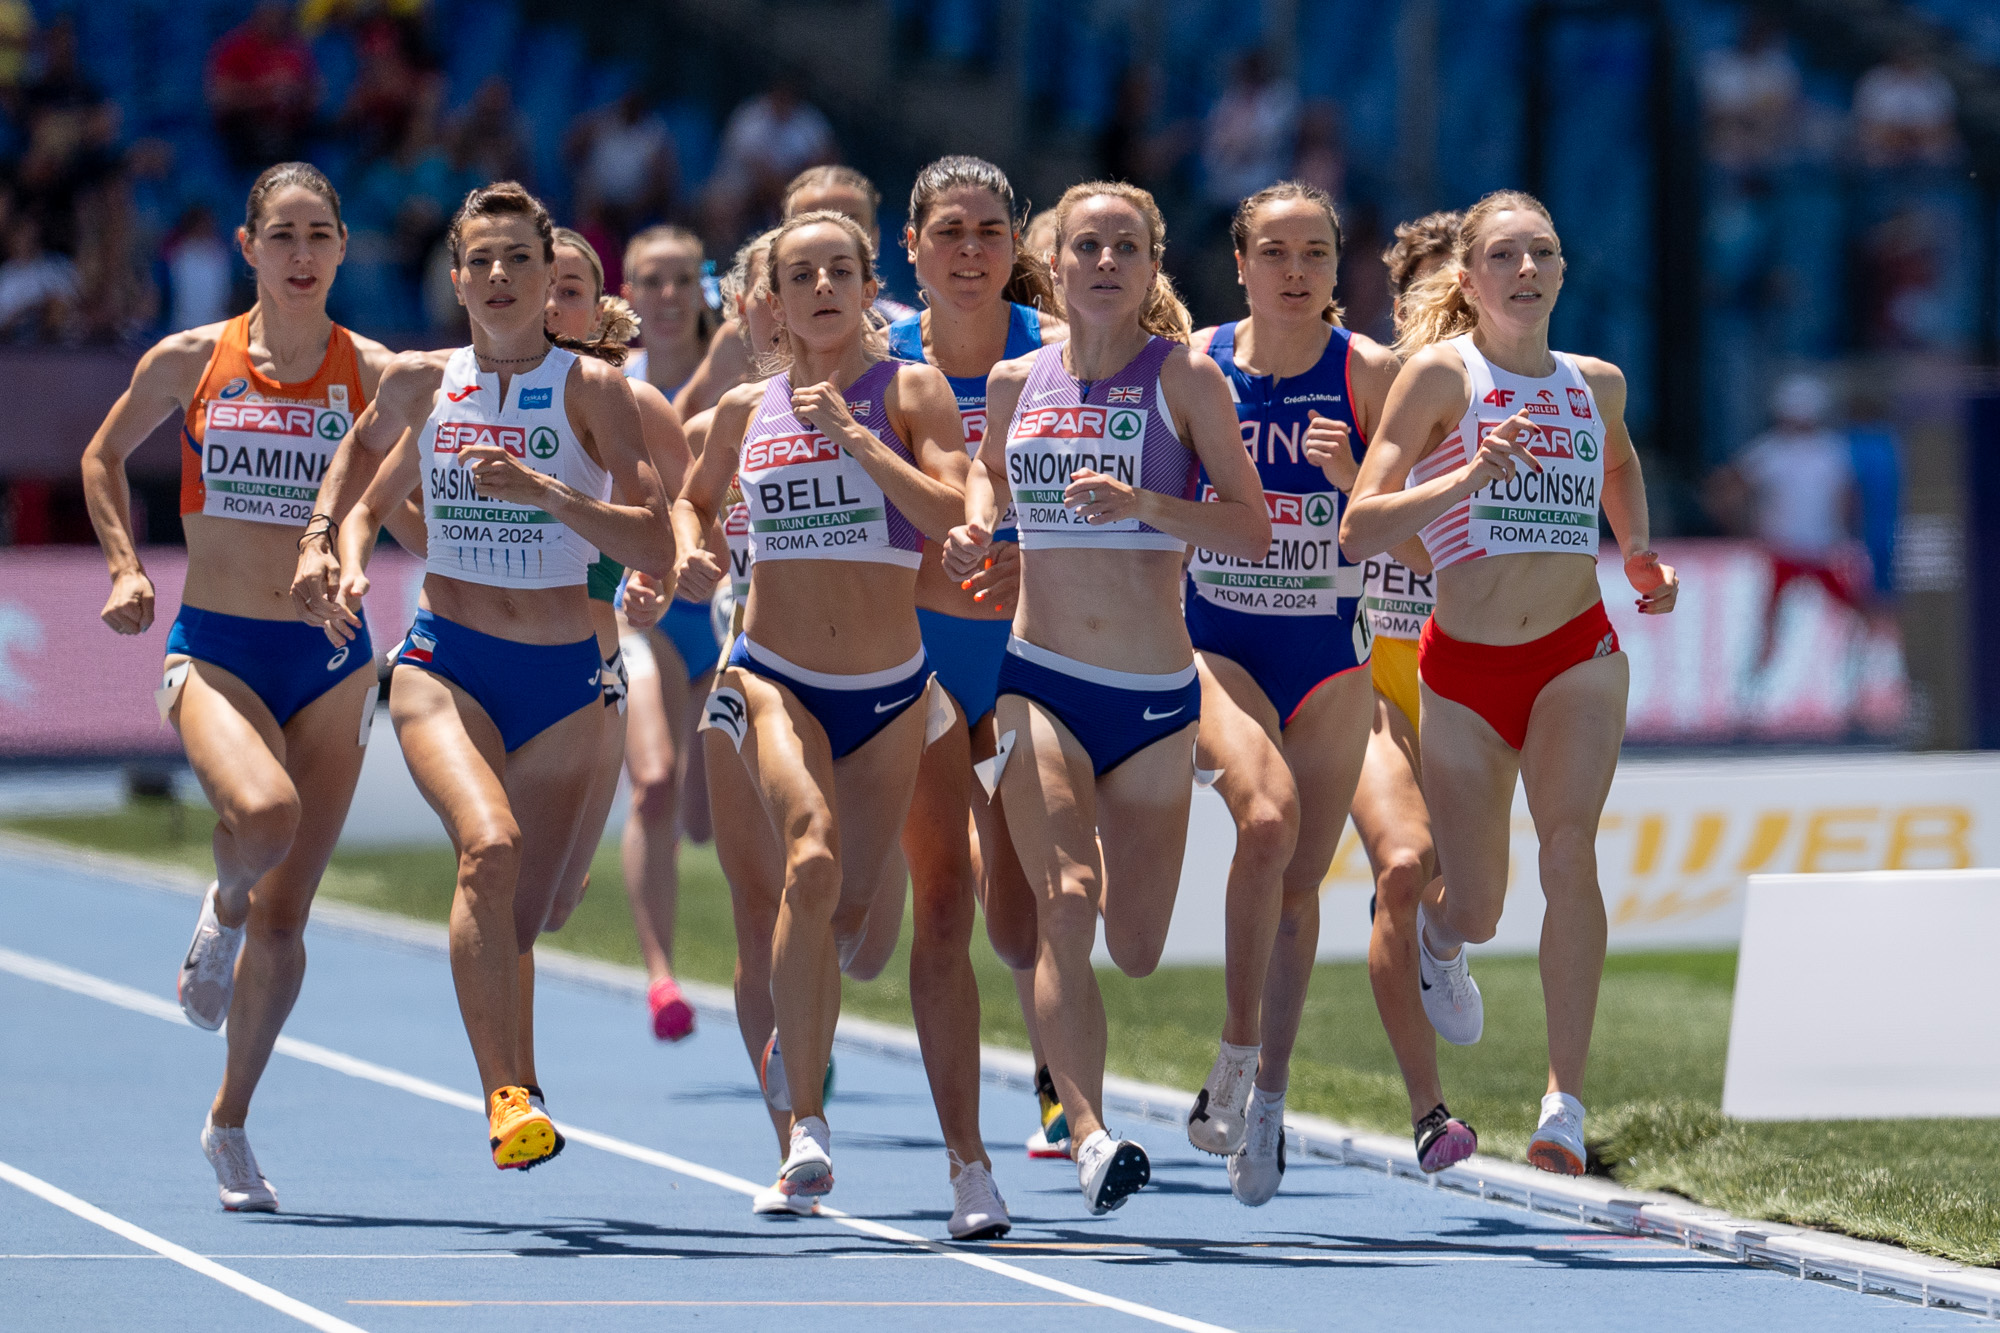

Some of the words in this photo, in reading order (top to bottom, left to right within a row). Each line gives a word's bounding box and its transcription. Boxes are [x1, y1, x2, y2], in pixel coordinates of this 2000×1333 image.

[1315, 394, 1341, 402] Mutuel
[1484, 389, 1516, 407] 4F
[212, 406, 312, 433] SPAR
[1527, 406, 1558, 414] ORLEN
[1018, 410, 1103, 436] SPAR
[437, 426, 523, 454] SPAR
[747, 436, 836, 468] SPAR
[236, 483, 266, 494] RUN
[759, 475, 861, 514] BELL
[1037, 491, 1059, 501] RUN
[1474, 465, 1595, 509] ŁOCIŃSKA
[224, 496, 275, 516] ROMA
[280, 503, 313, 520] 202
[454, 509, 482, 520] RUN
[1029, 507, 1069, 524] ROMA
[1508, 509, 1536, 521] RUN
[780, 518, 806, 529] RUN
[442, 524, 493, 542] ROMA
[498, 527, 544, 544] 2024
[766, 534, 819, 550] ROMA
[822, 528, 868, 546] 2024
[1490, 525, 1547, 544] ROMA
[1551, 529, 1589, 546] 2024
[1228, 574, 1257, 586] RUN
[1214, 587, 1264, 608] ROMA
[1273, 593, 1317, 608] 2024
[1384, 600, 1412, 613] RUN
